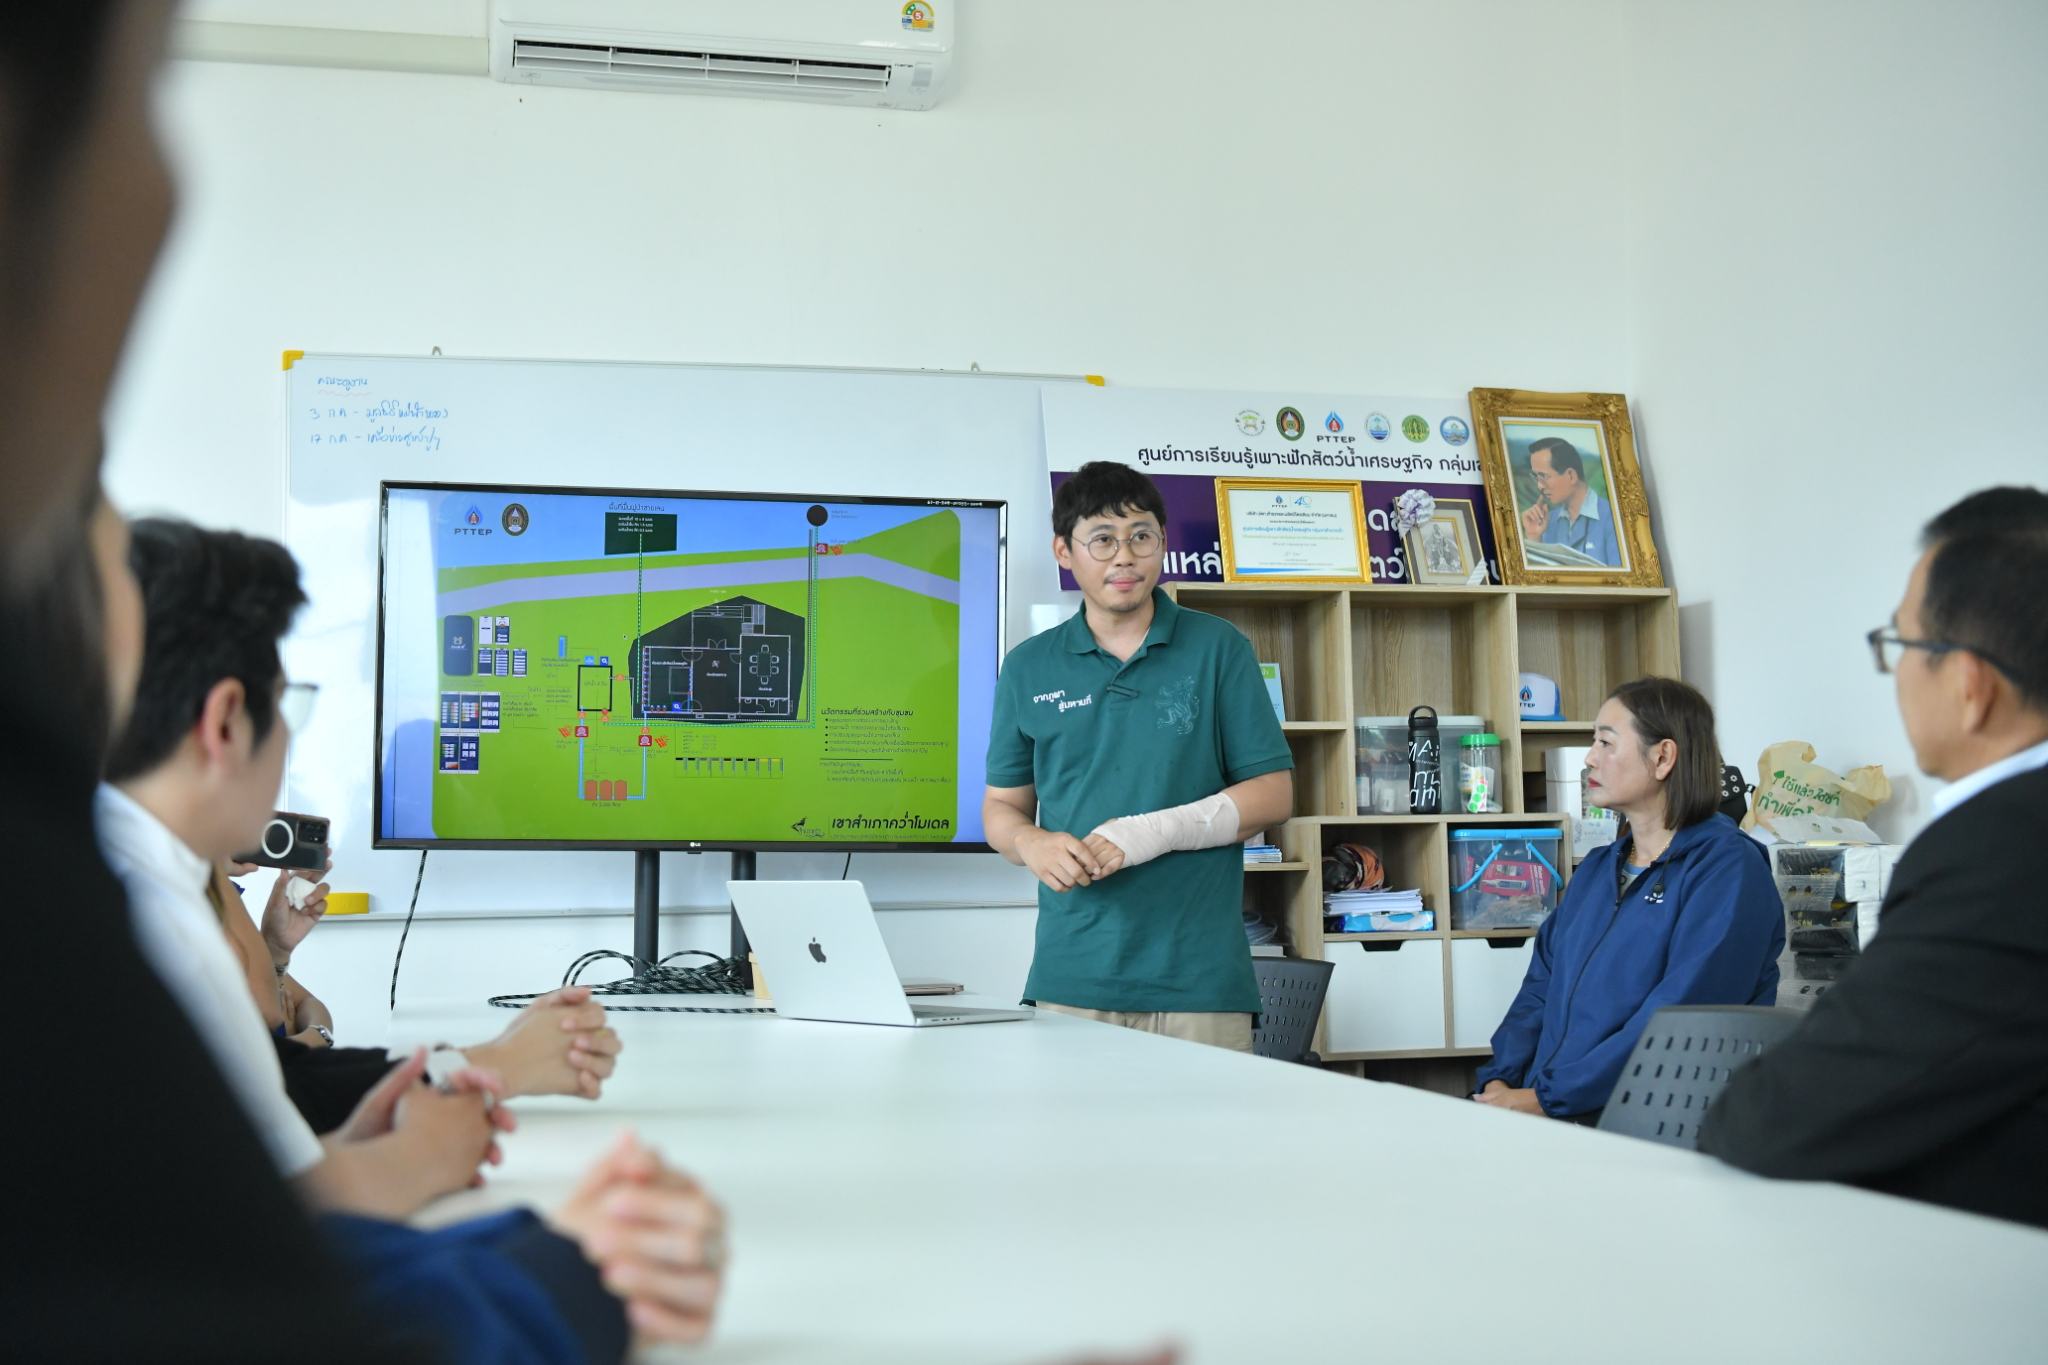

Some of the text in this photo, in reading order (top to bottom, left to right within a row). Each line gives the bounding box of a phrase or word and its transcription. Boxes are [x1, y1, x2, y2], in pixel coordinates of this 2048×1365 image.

[310, 408, 320, 420] 3
[1316, 435, 1356, 444] PTTEP
[1138, 444, 1433, 473] ศูนย์การเรียนรู้เพาะฟักสัตว์น้ำเศรษฐกิจ
[454, 528, 492, 536] PTTEP
[832, 811, 949, 830] เขาสำเภาคว่ำโมเดล
